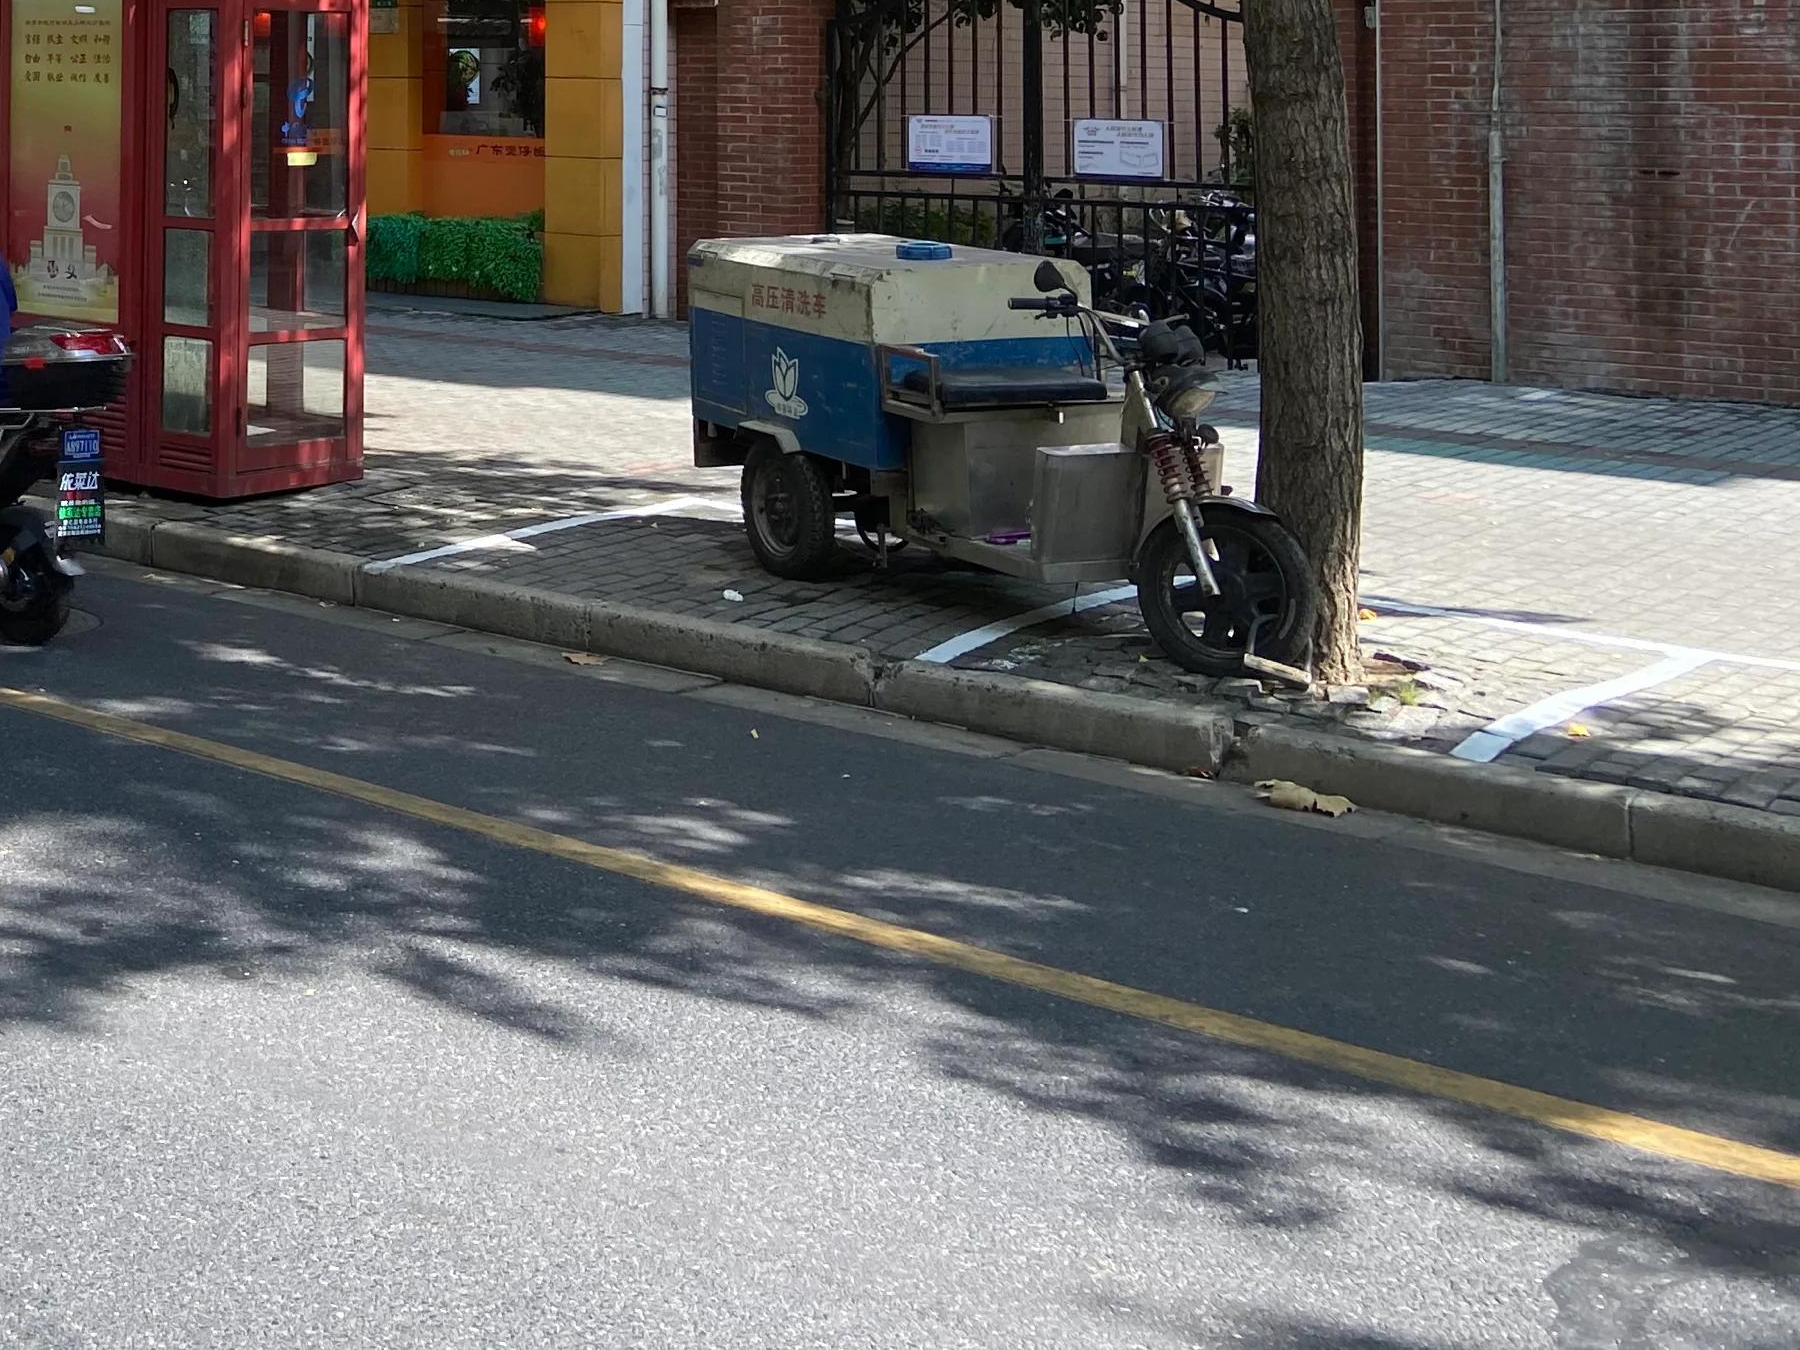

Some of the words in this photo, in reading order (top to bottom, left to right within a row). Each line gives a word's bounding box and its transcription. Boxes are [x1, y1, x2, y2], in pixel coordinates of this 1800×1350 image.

[751, 282, 827, 319] 高压清洗车
